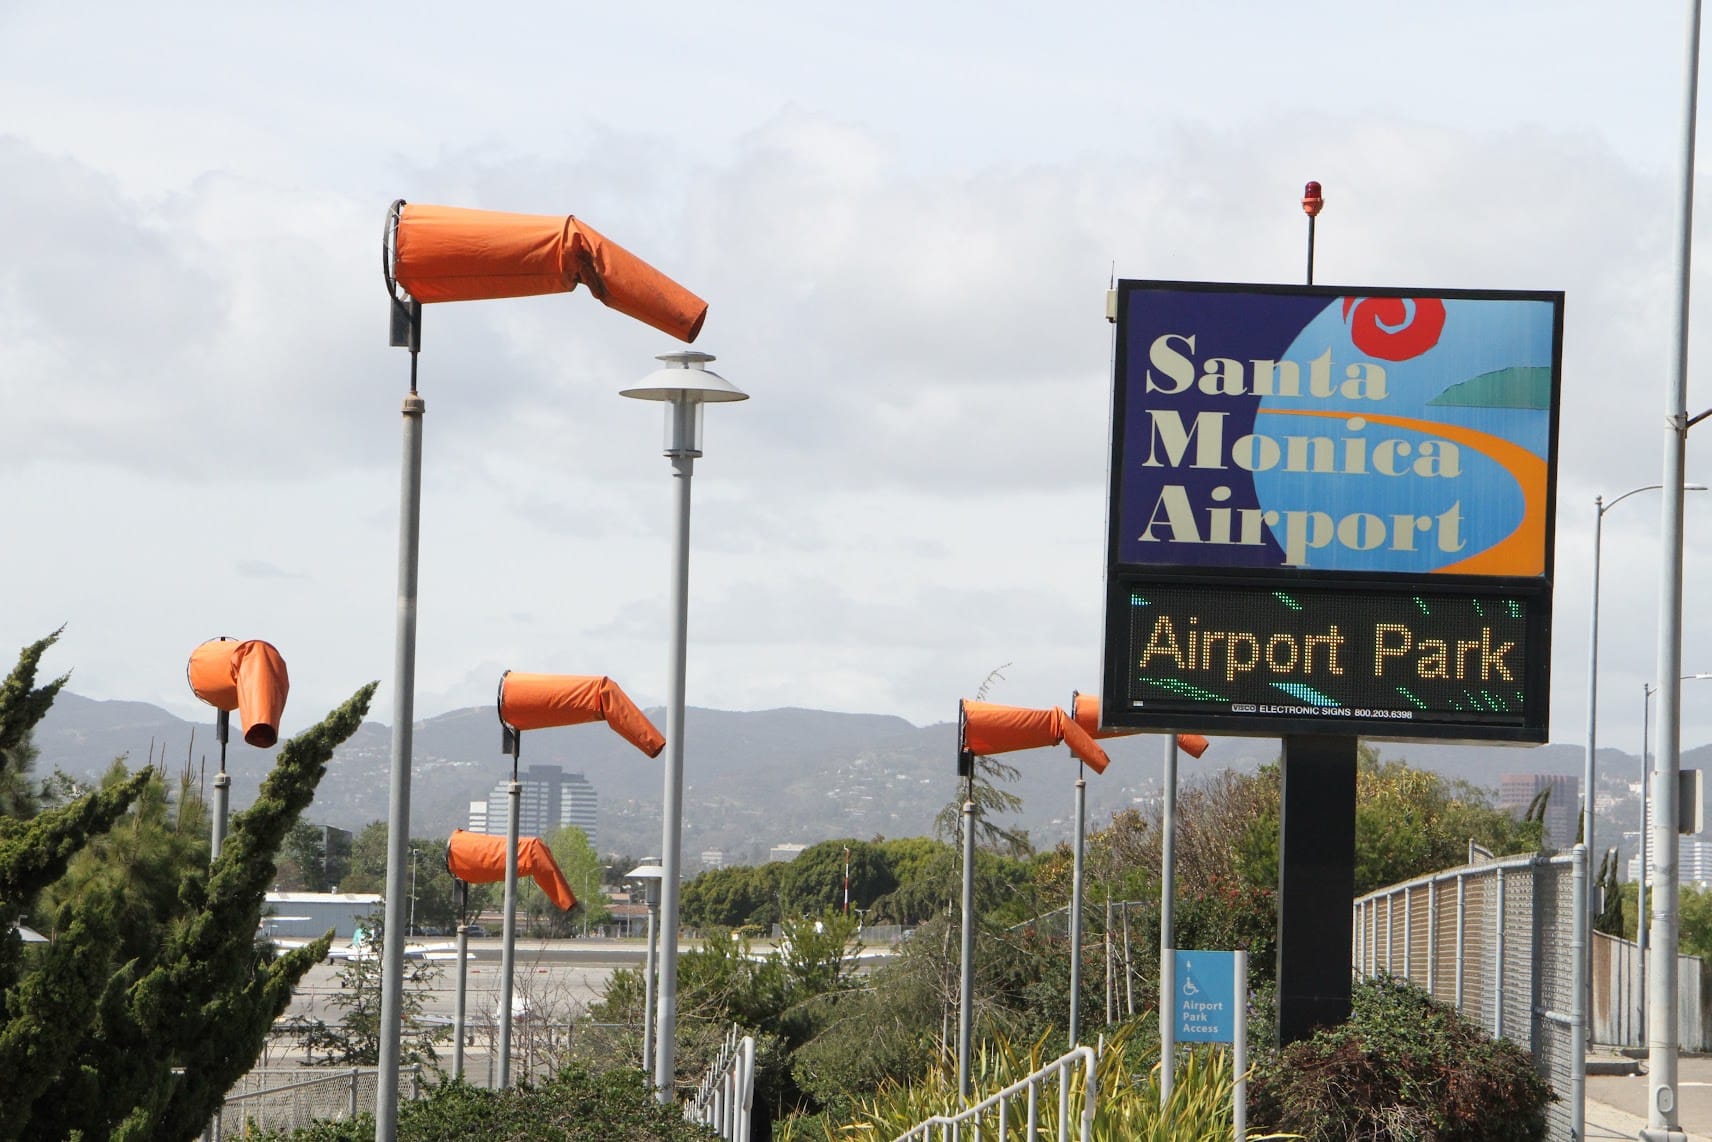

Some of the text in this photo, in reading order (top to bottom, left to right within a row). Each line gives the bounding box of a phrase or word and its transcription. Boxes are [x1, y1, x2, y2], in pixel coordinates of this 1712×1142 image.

[1146, 333, 1389, 401] Santa
[1141, 409, 1462, 478] Monica
[1137, 484, 1467, 567] Airport
[1139, 615, 1515, 681] Airport Park
[1259, 705, 1320, 716] ELECTRONIC
[1321, 707, 1351, 717] SIGNS
[1354, 708, 1413, 719] 800.203.6398
[1183, 1000, 1223, 1012] Airport
[1183, 1012, 1208, 1021] Park
[1183, 1023, 1218, 1033] Access
